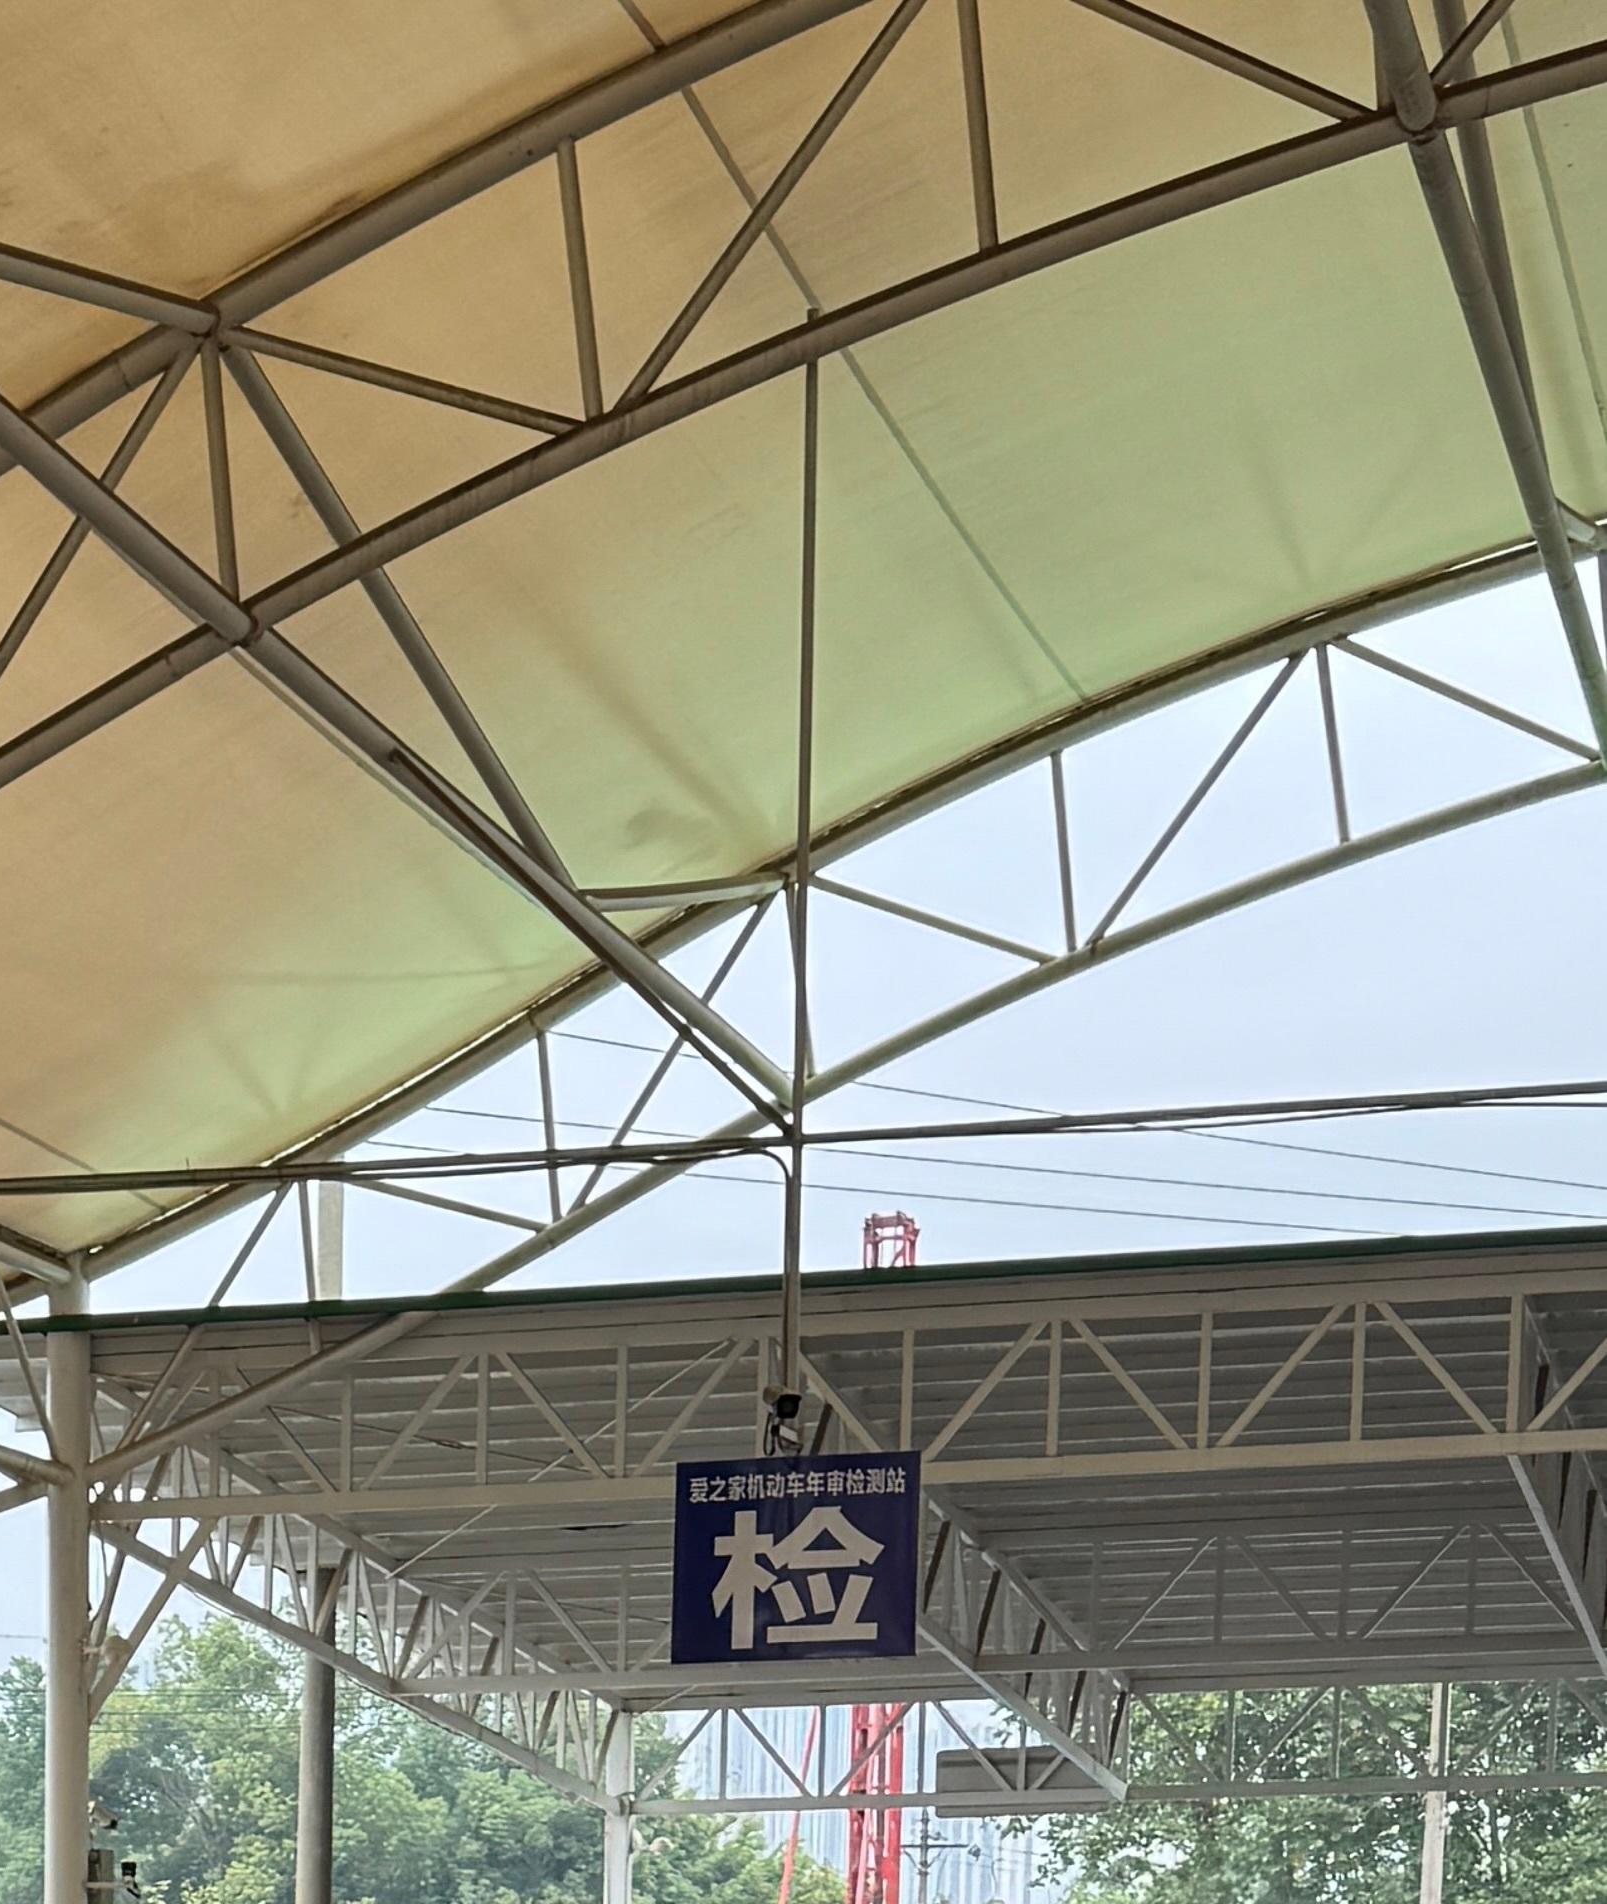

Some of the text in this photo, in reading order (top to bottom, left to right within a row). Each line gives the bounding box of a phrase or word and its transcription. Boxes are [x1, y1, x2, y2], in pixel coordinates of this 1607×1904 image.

[689, 1467, 906, 1504] 爱之家机动车年审检测站
[711, 1505, 885, 1650] 检
